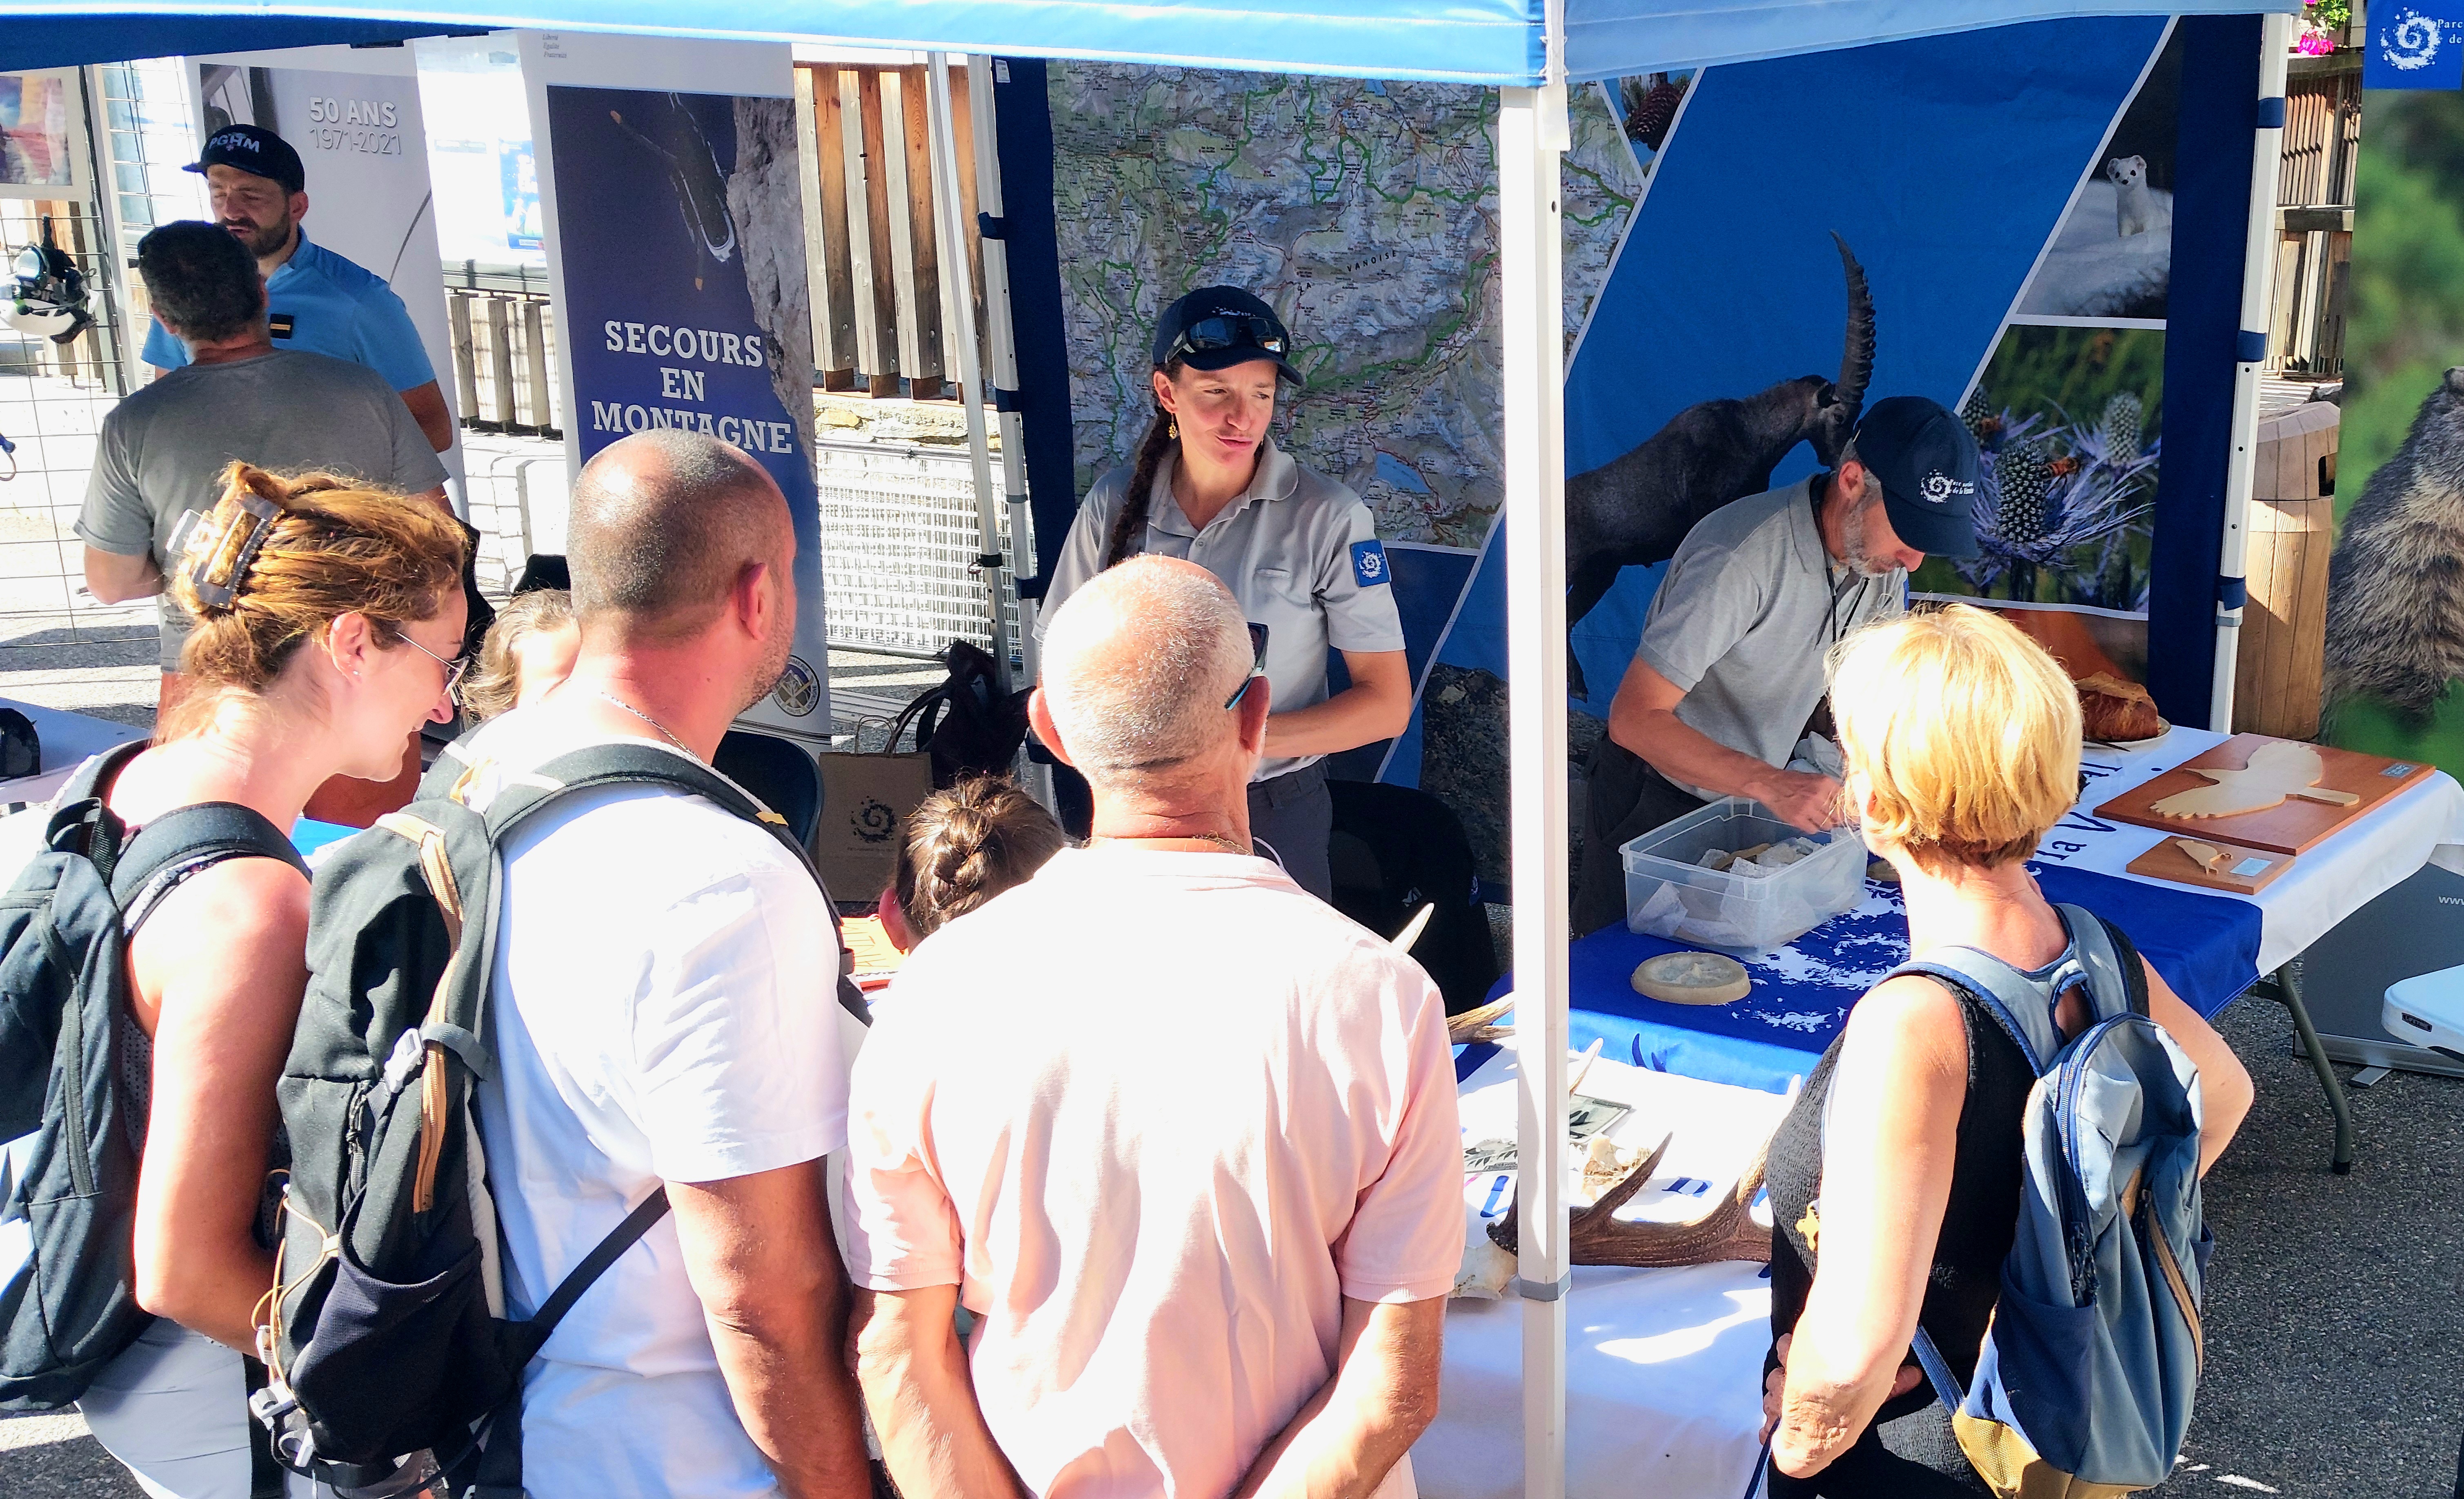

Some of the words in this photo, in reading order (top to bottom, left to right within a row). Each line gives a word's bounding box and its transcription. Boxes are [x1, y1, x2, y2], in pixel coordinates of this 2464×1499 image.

[2437, 19, 2463, 28] Parc
[309, 96, 340, 123] 50
[347, 99, 397, 128] ANS
[209, 134, 260, 153] PGHM
[309, 127, 401, 155] 1971-2021
[1347, 249, 1397, 272] VANOISE
[605, 320, 763, 367] SECOURS
[660, 367, 705, 402] EN
[591, 400, 792, 454] MONTAGNE
